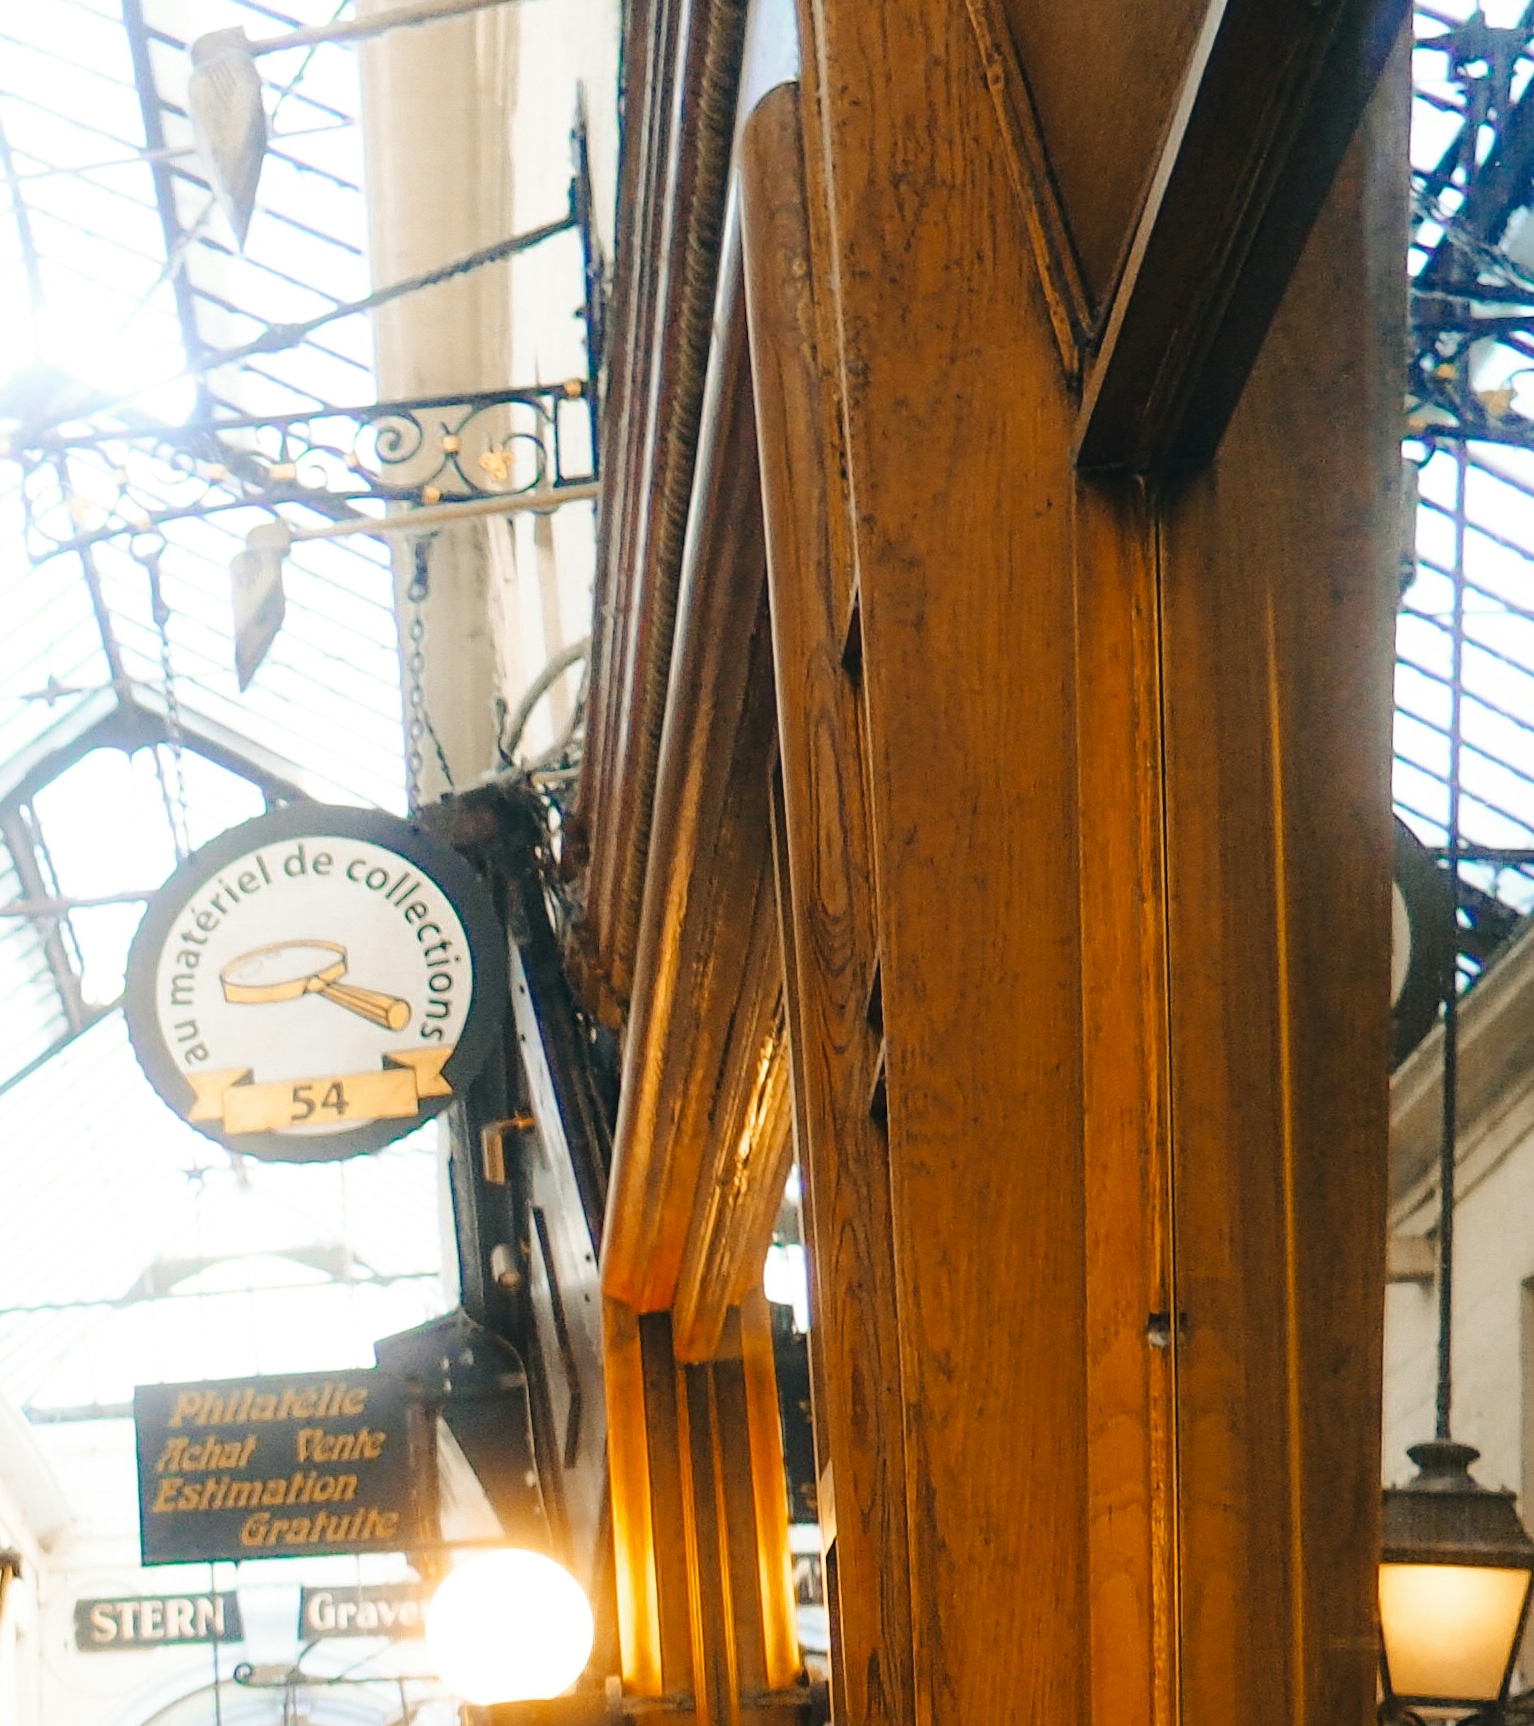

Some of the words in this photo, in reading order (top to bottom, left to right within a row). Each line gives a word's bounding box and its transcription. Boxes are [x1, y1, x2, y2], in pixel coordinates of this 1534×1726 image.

[283, 843, 333, 878] de
[170, 855, 273, 1006] matériel
[345, 857, 464, 1043] collections
[174, 1018, 210, 1066] au
[291, 1081, 350, 1121] 54
[156, 1434, 257, 1473] Achat
[296, 1427, 386, 1463] Vente
[152, 1470, 358, 1513] Estimation
[240, 1507, 400, 1547] Gratuite
[90, 1596, 226, 1645] STERN
